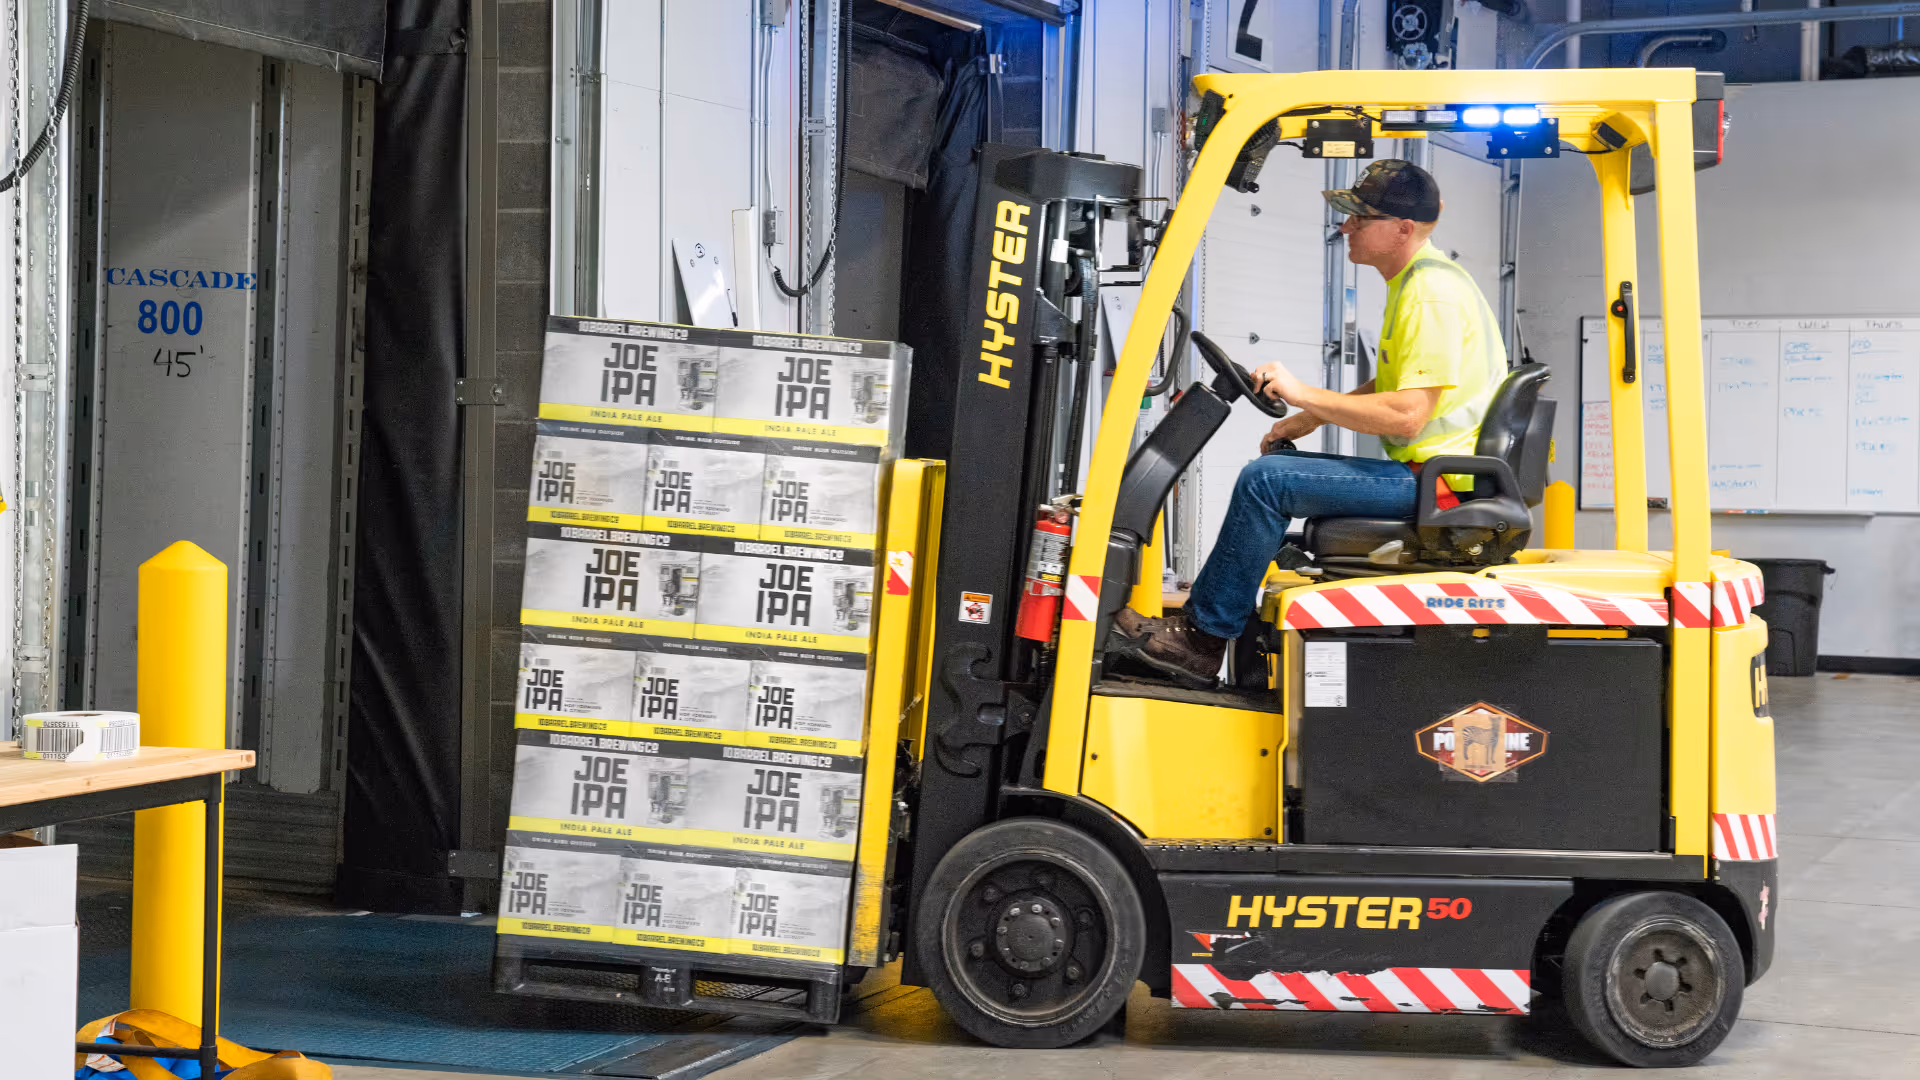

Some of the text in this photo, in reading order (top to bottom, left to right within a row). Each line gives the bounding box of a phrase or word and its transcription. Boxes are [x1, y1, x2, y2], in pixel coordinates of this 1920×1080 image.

[108, 268, 256, 290] CASCADE
[978, 200, 1030, 389] HYSTER
[138, 300, 203, 336] 800
[604, 343, 658, 371] JOE
[778, 356, 832, 385] JOE
[600, 370, 656, 406] IPA
[775, 384, 830, 419] IPA
[590, 410, 662, 423] INDIA PALE ALE
[539, 461, 575, 480] JOE
[656, 471, 692, 490] JOE
[536, 479, 574, 503] IPA
[653, 489, 690, 513] IPA
[773, 480, 809, 499] JOE
[771, 498, 807, 523] IPA
[586, 548, 640, 577] JOE
[760, 563, 814, 592] JOE
[582, 576, 638, 611] IPA
[1427, 598, 1464, 608] RIDE
[756, 591, 811, 626] IPA
[572, 615, 644, 628] INDIA PALE ALE
[745, 631, 817, 644] INDIA PALE ALE
[527, 668, 564, 687] JOE
[643, 677, 679, 697] JOE
[525, 687, 562, 712] IPA
[758, 686, 794, 705] JOE
[640, 696, 677, 720] IPA
[756, 704, 792, 729] IPA
[574, 755, 629, 784] JOE
[747, 769, 802, 798] JOE
[570, 782, 627, 819] IPA
[744, 796, 800, 833] IPA
[560, 823, 632, 836] INDIA PALE ALE
[733, 836, 804, 849] INDIA PALE ALE
[512, 872, 548, 892] JOE
[626, 883, 663, 903] JOE
[509, 891, 547, 915] IPA
[624, 902, 660, 927] IPA
[742, 894, 779, 913] JOE
[1226, 895, 1473, 930] HYSTER 50
[739, 913, 776, 938] IPA
